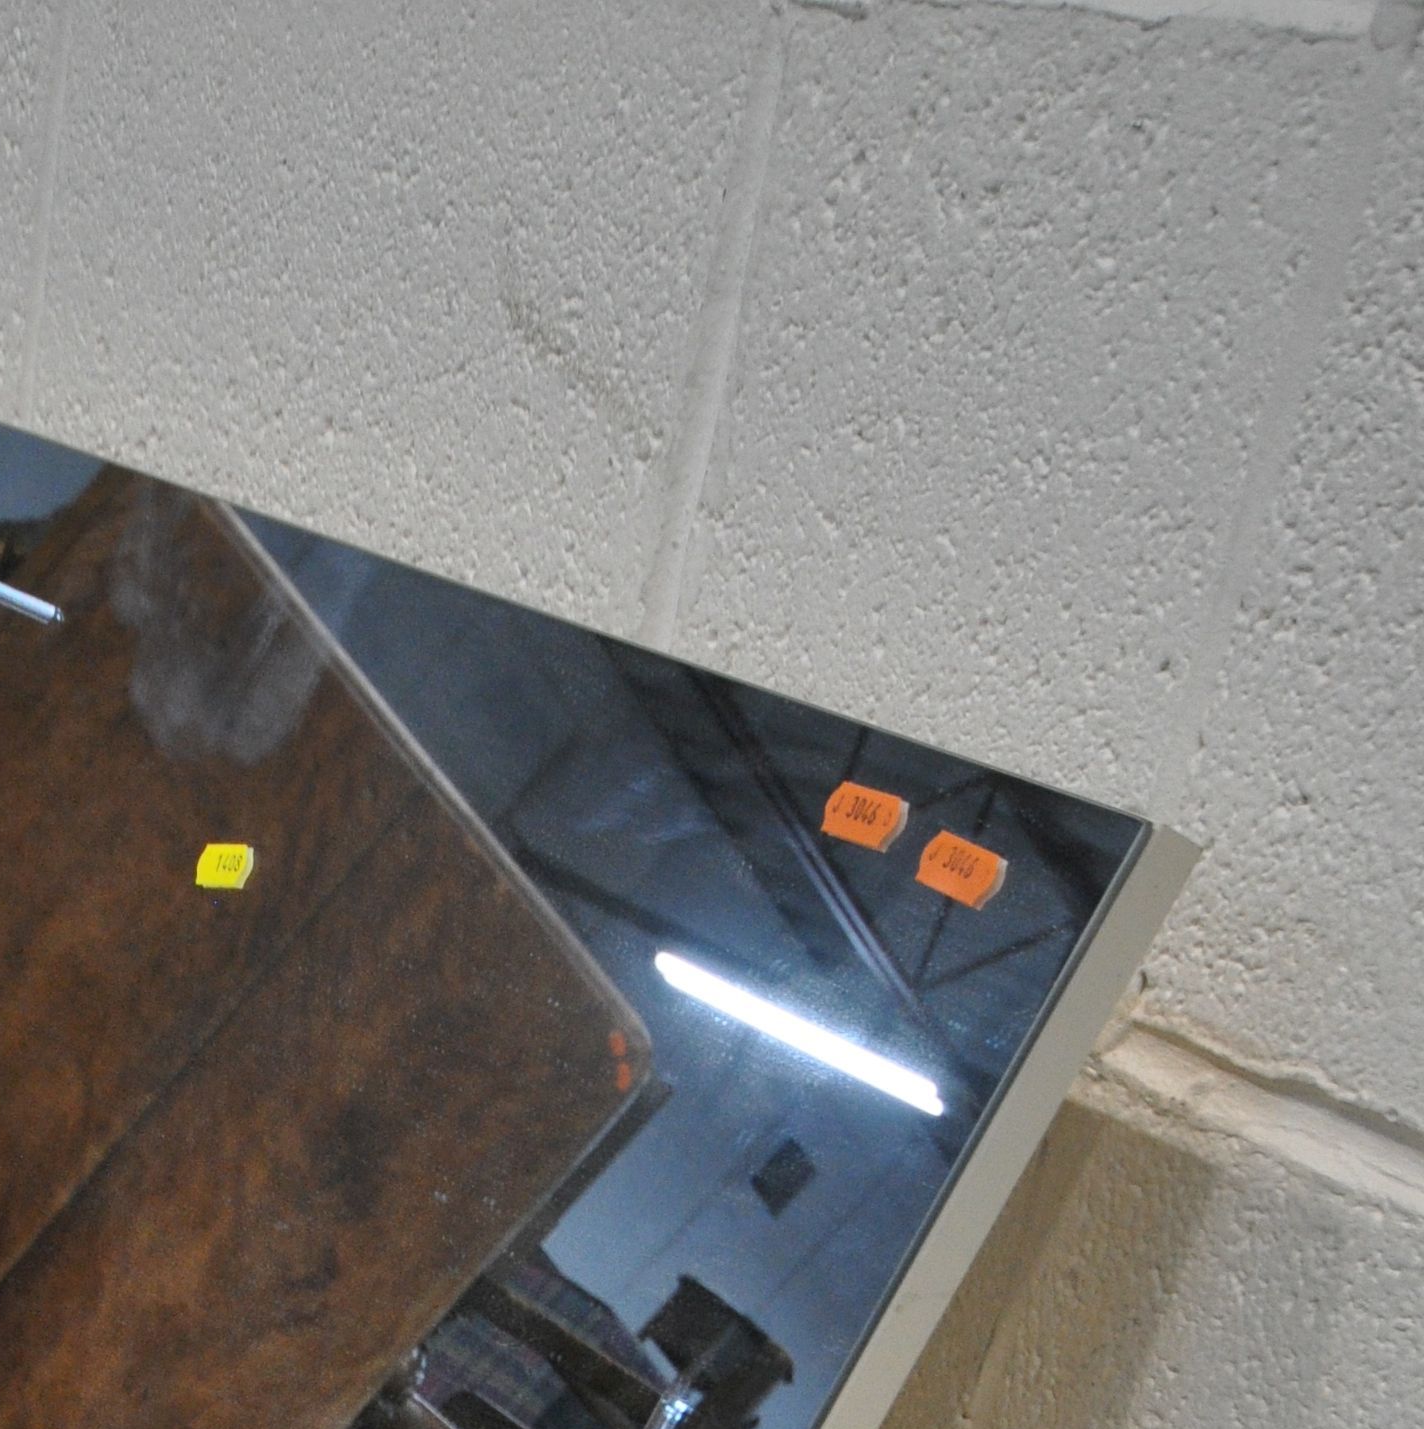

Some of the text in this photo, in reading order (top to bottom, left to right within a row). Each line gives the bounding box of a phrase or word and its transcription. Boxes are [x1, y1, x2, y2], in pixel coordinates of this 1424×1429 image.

[845, 796, 881, 826] 3046
[215, 853, 243, 872] 1408
[942, 846, 979, 879] 3046
